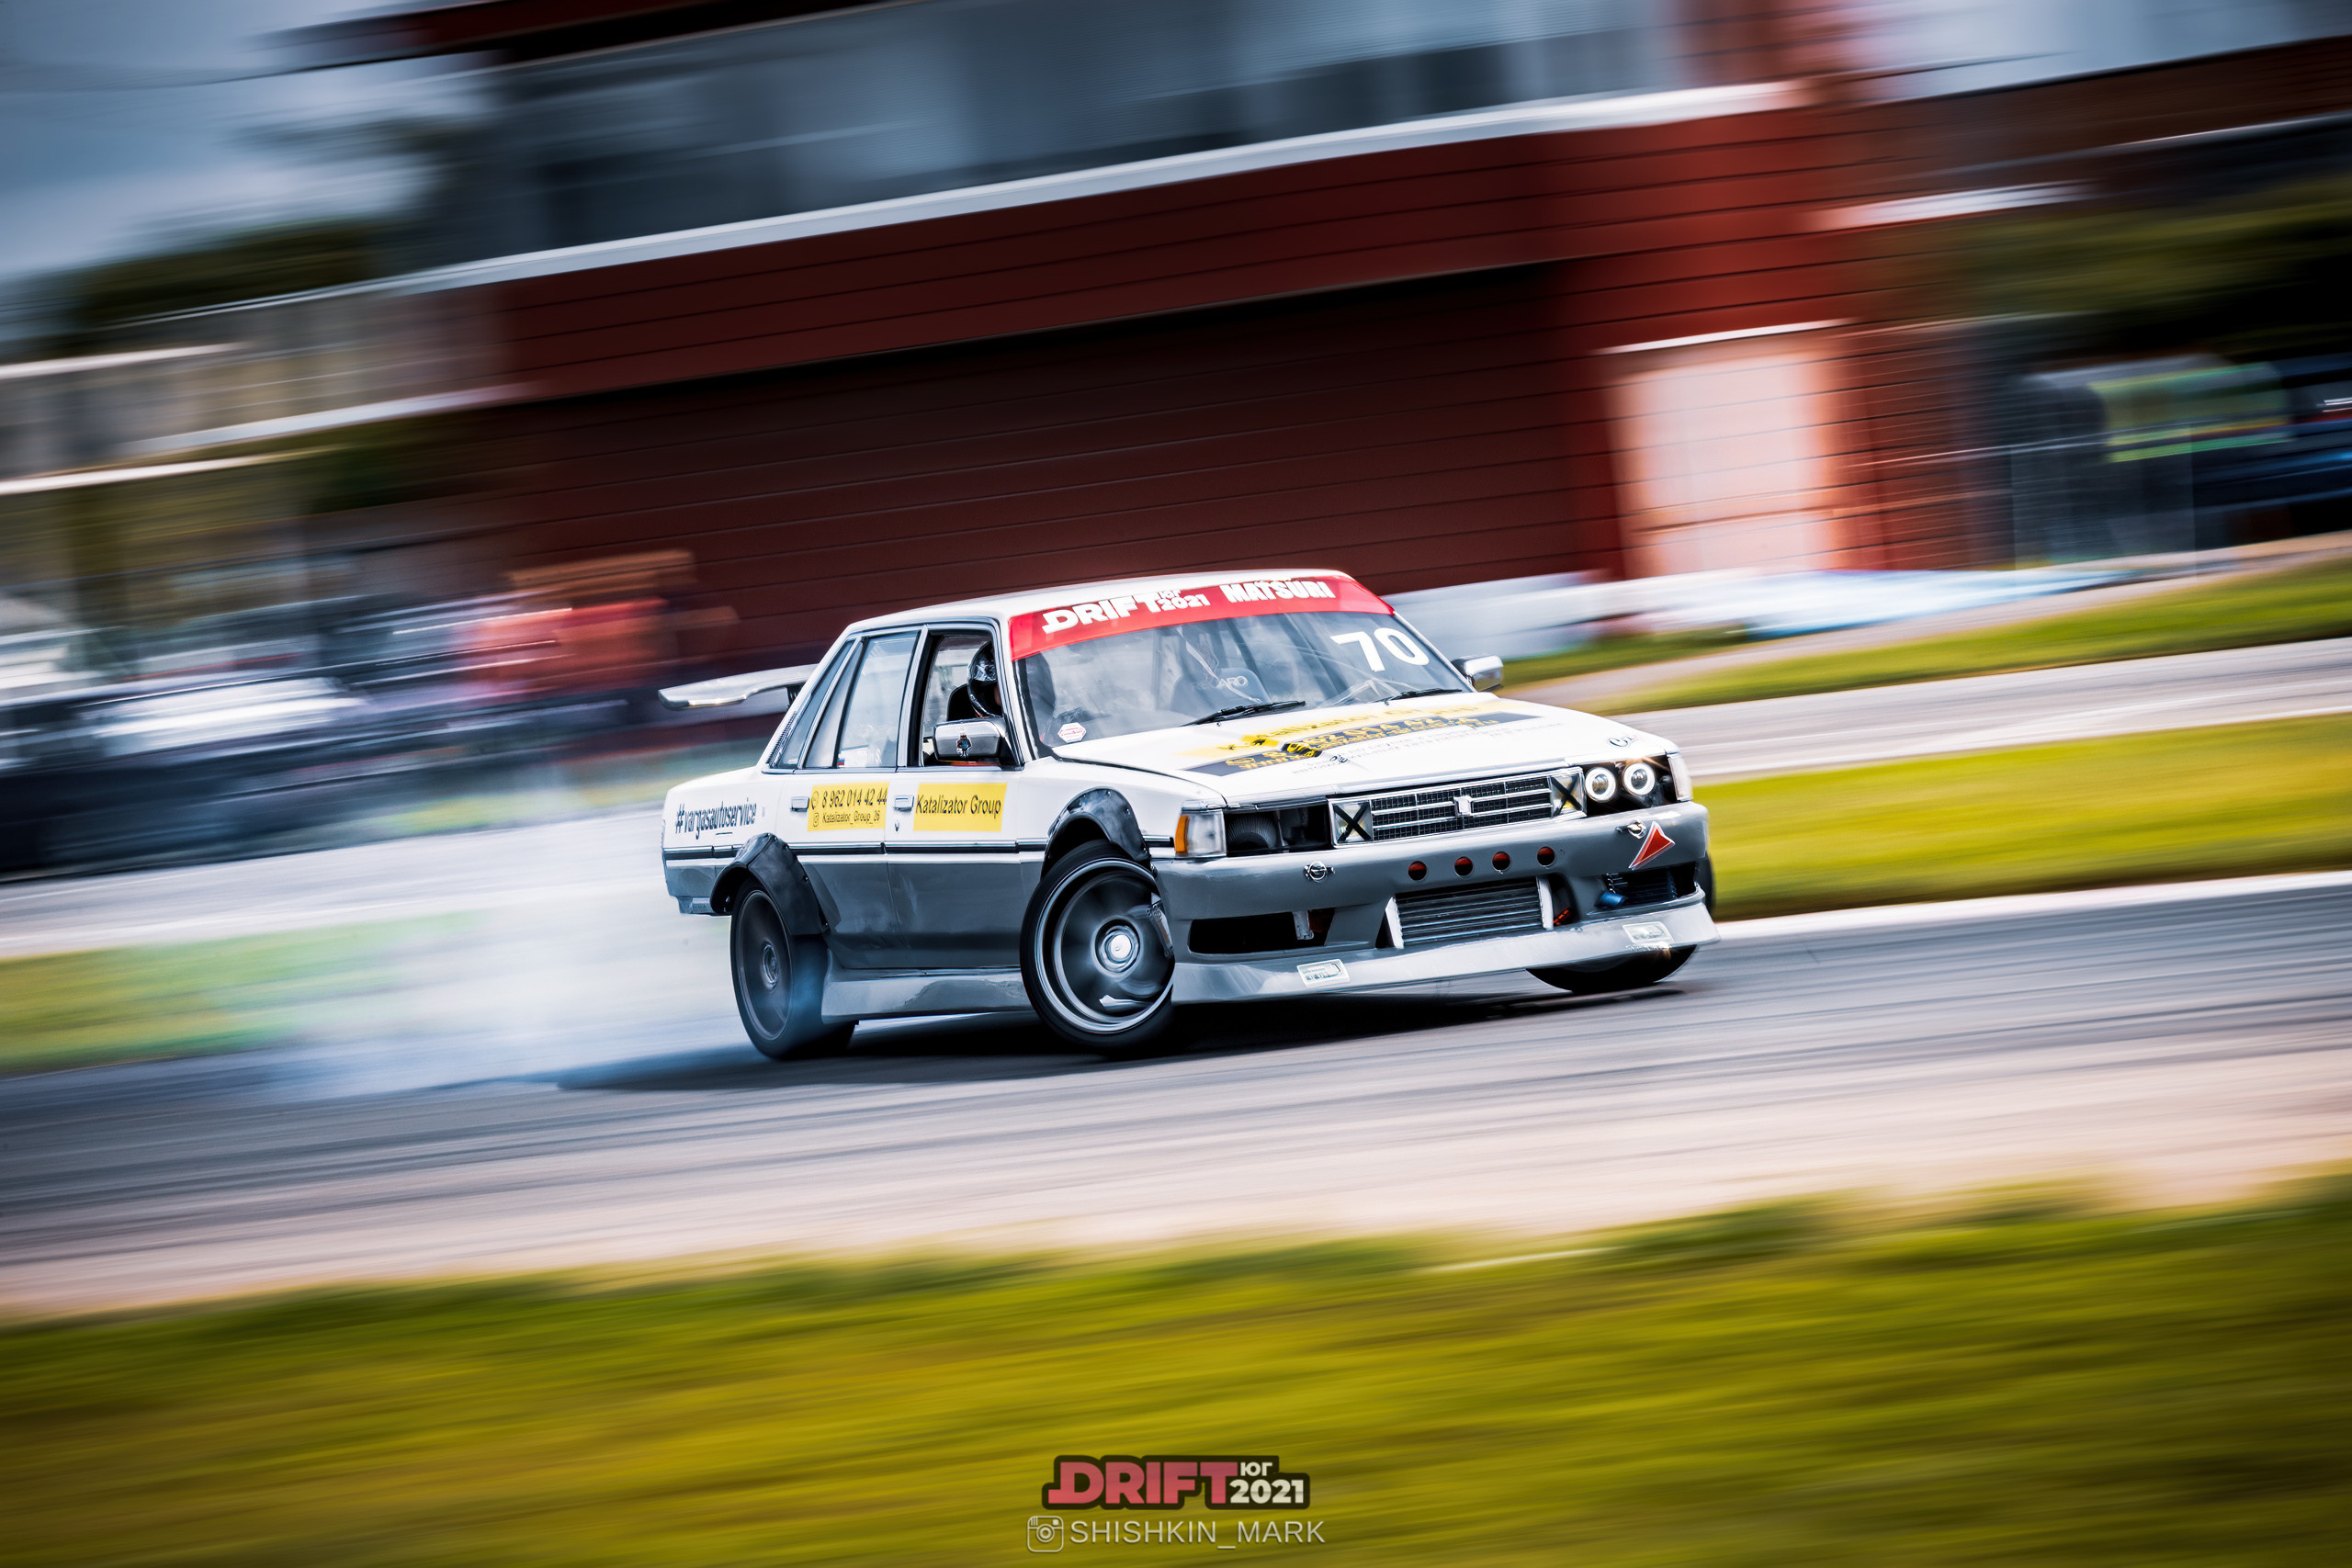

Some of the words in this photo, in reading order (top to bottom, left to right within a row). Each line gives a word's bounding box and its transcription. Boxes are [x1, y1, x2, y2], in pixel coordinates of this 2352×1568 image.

[1158, 593, 1211, 612] 2021
[1219, 580, 1336, 603] MATSURI
[1041, 592, 1161, 635] DRIFT
[1329, 627, 1430, 672] 70
[821, 790, 829, 808] 8
[830, 789, 845, 807] 962
[846, 788, 863, 807] 014
[865, 788, 876, 807] 42
[876, 787, 888, 806] 44
[915, 794, 967, 814] Katalizator
[970, 794, 1001, 819] Group
